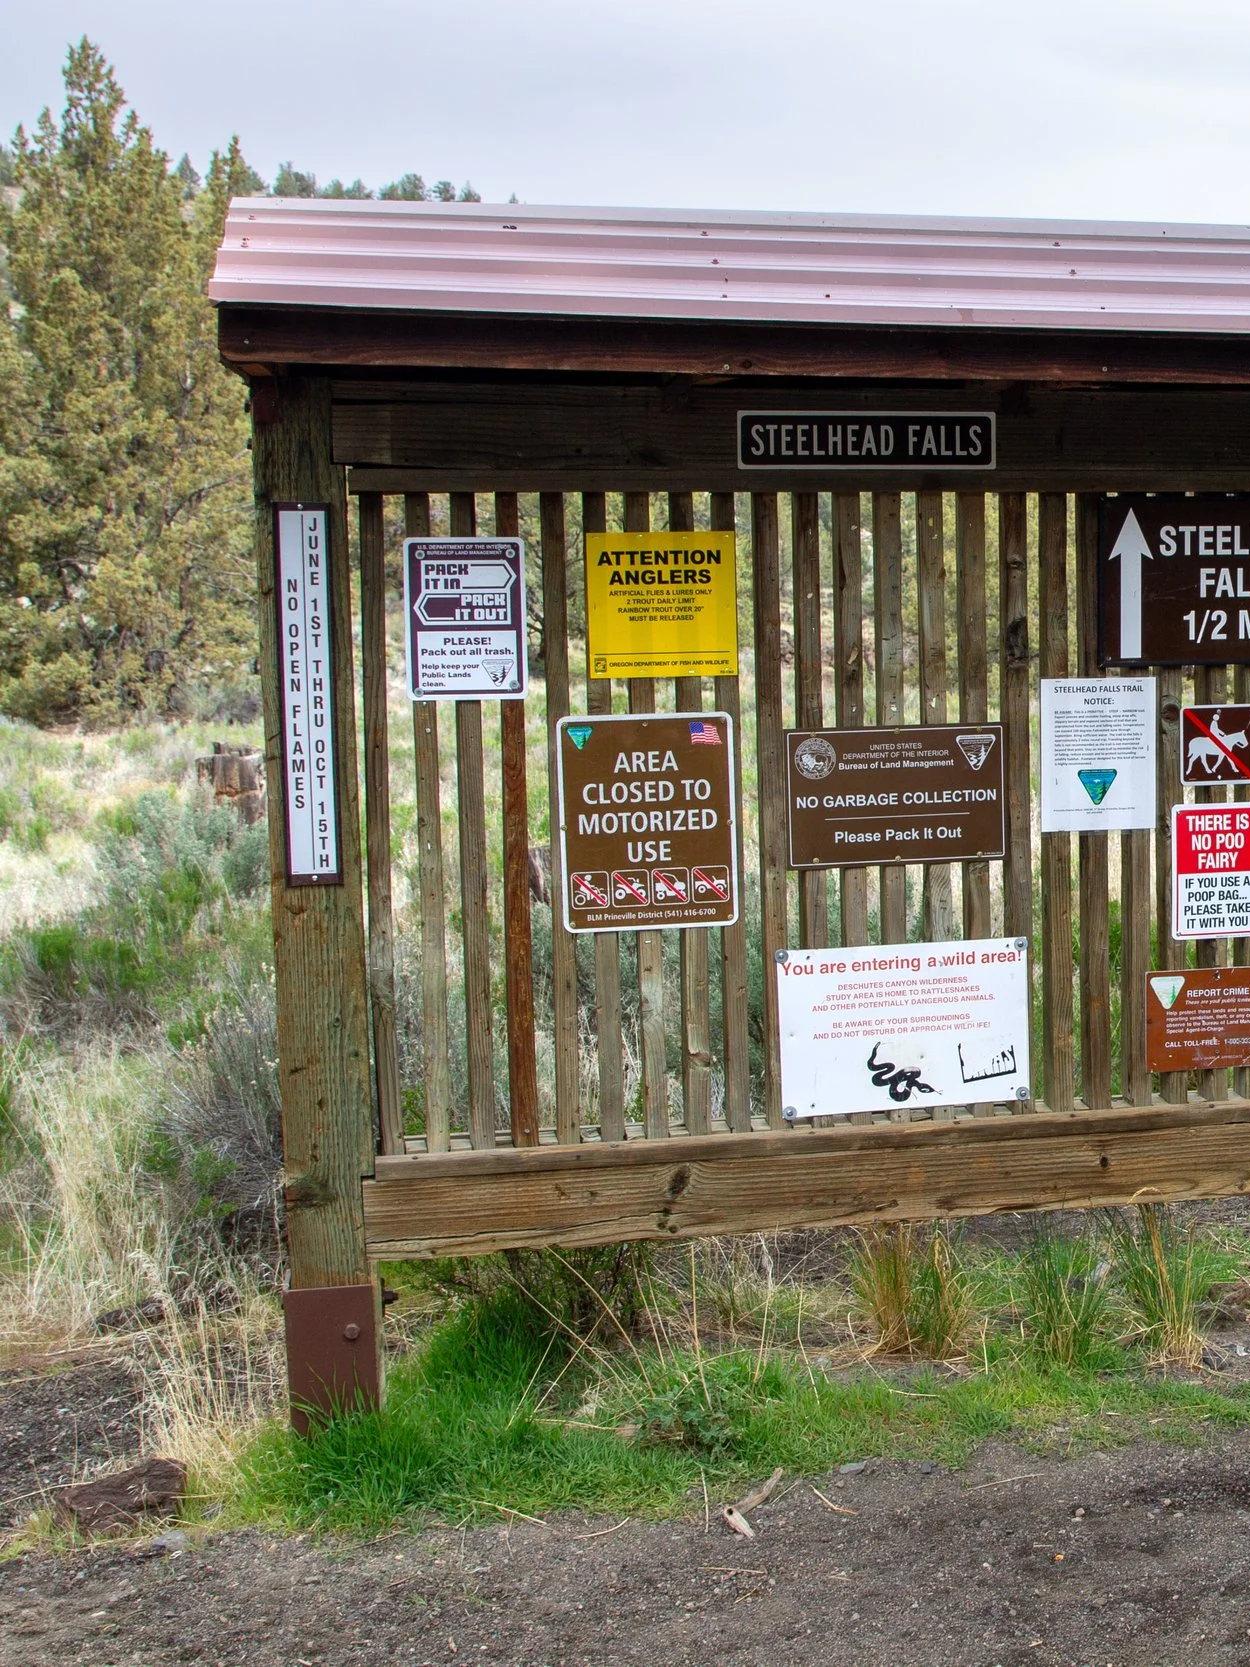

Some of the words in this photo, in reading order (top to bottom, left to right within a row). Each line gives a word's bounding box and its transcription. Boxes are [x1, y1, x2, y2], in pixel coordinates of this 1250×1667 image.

[750, 424, 895, 456] STEELHEAD
[908, 425, 983, 456] FALLS
[308, 517, 320, 586] JUNE
[597, 550, 721, 566] ATTENTION
[425, 564, 469, 575] PACK
[609, 569, 711, 585] ANGLERS
[425, 578, 441, 590] IT
[287, 578, 298, 612] NO
[461, 594, 506, 606] PACK
[455, 609, 472, 620] IT
[474, 608, 506, 620] OUT
[311, 598, 320, 648] 1ST
[1183, 609, 1227, 642] 1/2
[444, 637, 491, 645] PLEASE!
[288, 623, 301, 692] OPEN
[312, 660, 324, 727] THRU
[292, 705, 305, 809] FLAMES
[315, 739, 326, 789] OCT
[614, 751, 678, 773] AREA
[843, 751, 889, 760] DEPARTMENT
[838, 762, 867, 770] Bureau
[903, 759, 954, 769] Management
[583, 781, 674, 805] CLOSED
[681, 779, 711, 800] TO
[796, 797, 818, 808] NO
[823, 793, 898, 808] GARBAGE
[903, 789, 996, 804] COLLECTION
[579, 808, 717, 835] MOTORIZED
[1186, 814, 1232, 832] THERE
[1236, 813, 1250, 829] IS
[317, 802, 330, 868] 15TH
[835, 830, 881, 843] Please
[886, 828, 919, 840] Pack
[924, 828, 933, 839] It
[937, 826, 962, 838] Out
[1191, 834, 1211, 850] NO
[1216, 832, 1245, 850] POO
[628, 840, 672, 863] USE
[1198, 852, 1238, 870] FAIRY
[1185, 878, 1195, 889] IF
[1197, 877, 1217, 888] YOU
[1221, 876, 1240, 887] USE
[1243, 876, 1250, 886] A
[1188, 891, 1215, 902] POOP
[1218, 889, 1248, 900] BAG...
[604, 912, 636, 920] Prineville
[665, 909, 682, 918] (541)
[1184, 904, 1222, 916] PLEASE
[1186, 919, 1195, 929] IT
[1199, 917, 1225, 928] WITH
[1228, 916, 1248, 927] YOU
[781, 962, 813, 976] You
[820, 961, 846, 974] are
[852, 955, 921, 973] entering
[928, 958, 936, 968] a
[942, 951, 975, 966] wild
[981, 950, 1022, 965] area!
[838, 981, 883, 991] DESCHUTES
[885, 979, 917, 988] CANYON
[919, 976, 968, 986] WILDERNESS
[826, 993, 851, 1002] STUDY
[853, 992, 874, 1000] AREA
[885, 990, 907, 998] HOME
[921, 985, 980, 995] RATTLESNAKES
[1187, 989, 1220, 998] REPORT
[1223, 988, 1250, 996] CRIME
[812, 1004, 828, 1012] AND
[830, 1002, 856, 1011] OTHER
[858, 998, 909, 1010] POTENTIALLY
[911, 995, 958, 1005] DANGEROUS
[960, 993, 995, 1002] ANIMALS.
[844, 1019, 872, 1029] AWARE
[887, 1016, 908, 1026] YOUR
[910, 1013, 970, 1024] SURROUNDINGS
[813, 1031, 829, 1040] AND
[862, 1027, 895, 1036] DISTURB
[910, 1024, 952, 1034] APPROACH
